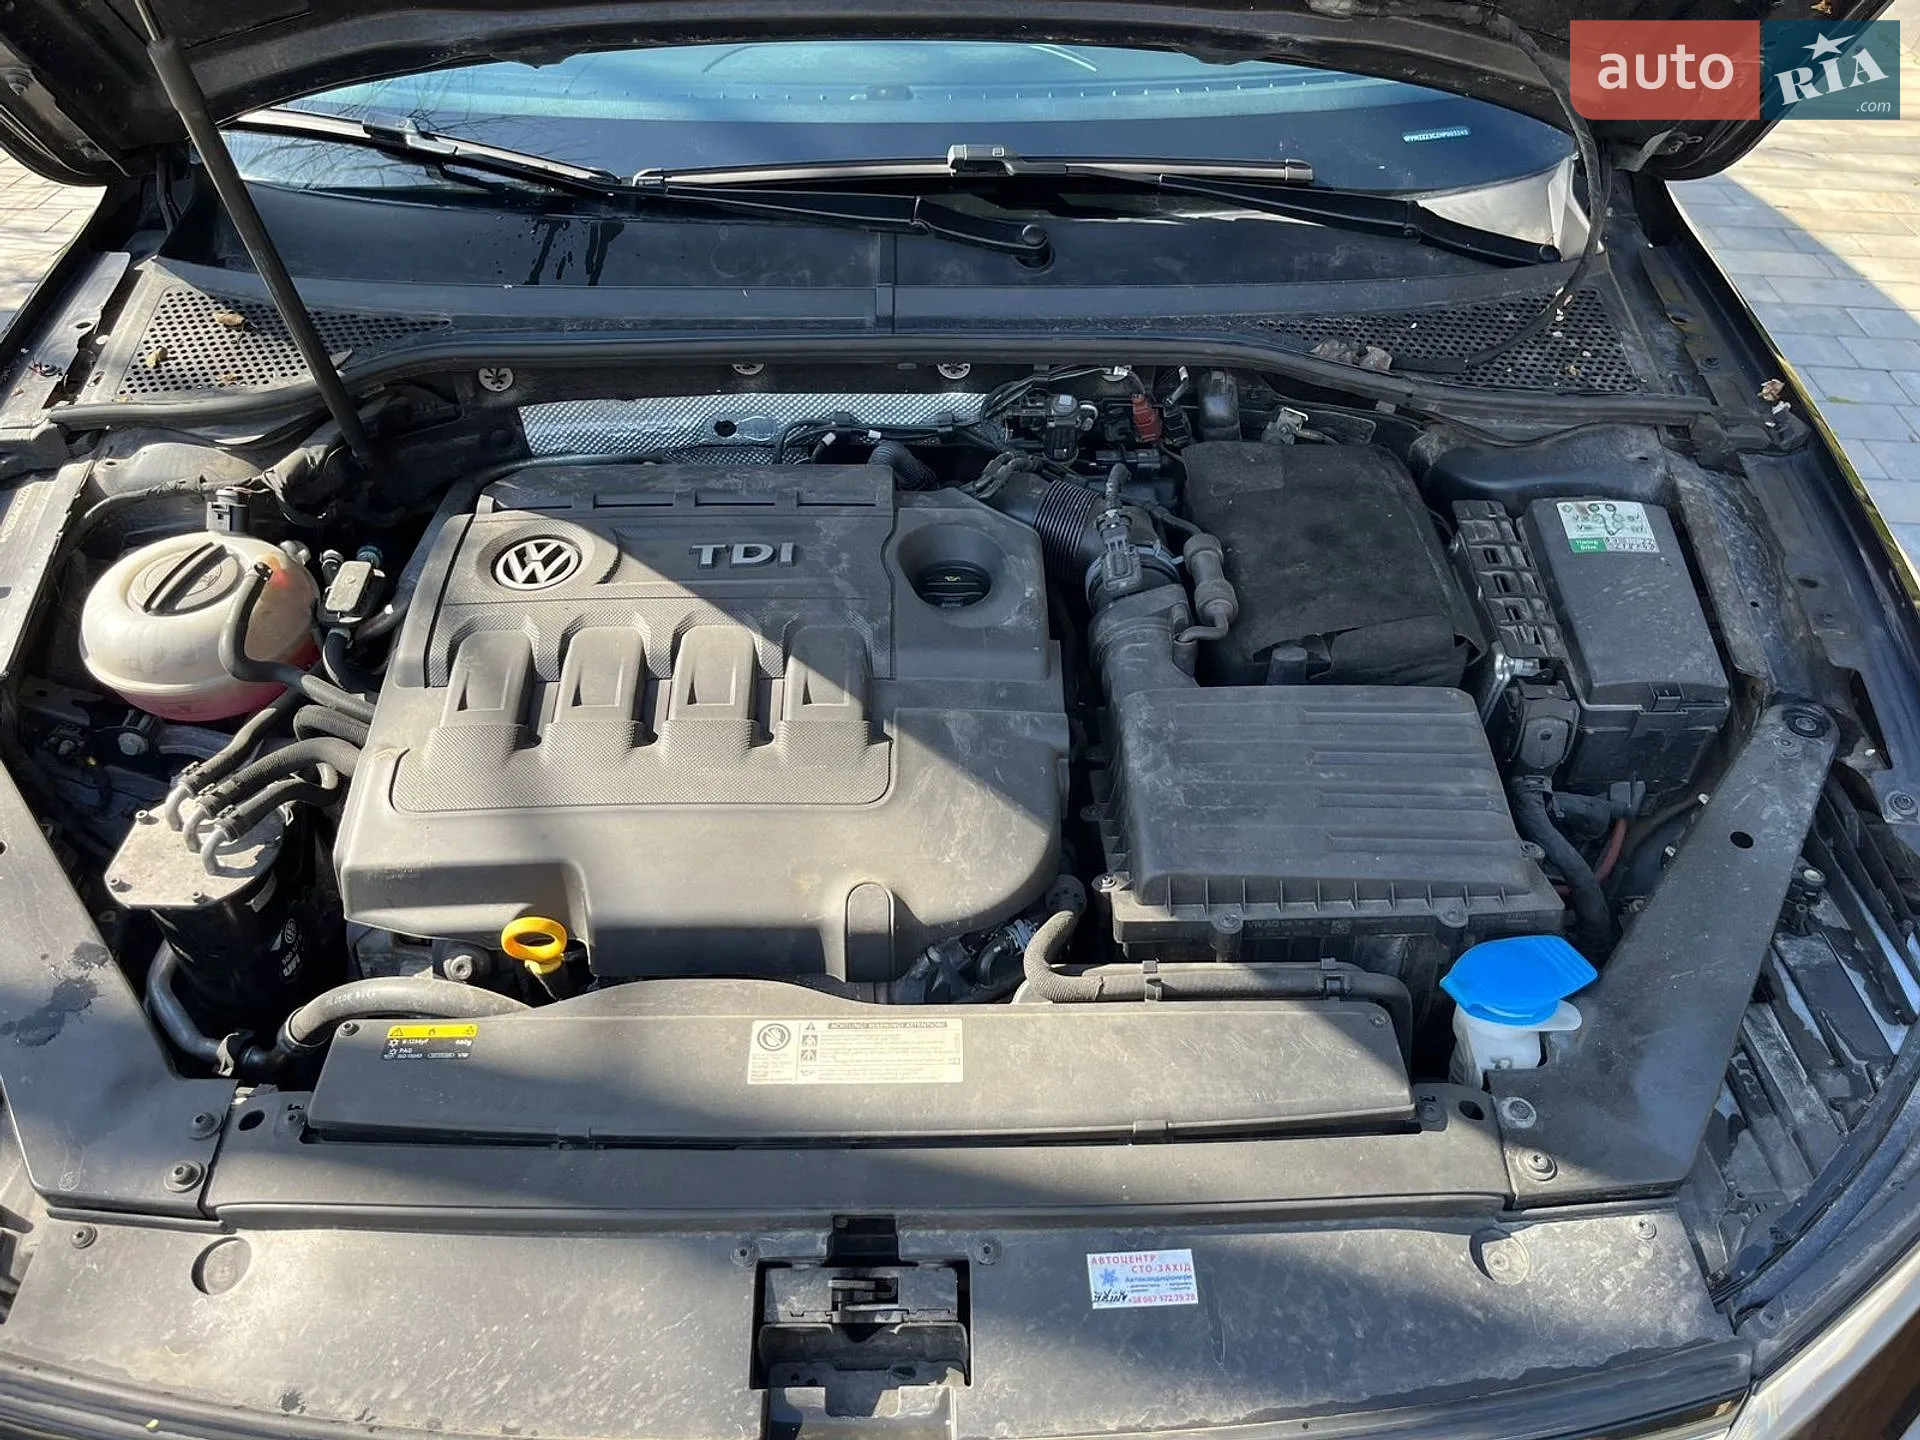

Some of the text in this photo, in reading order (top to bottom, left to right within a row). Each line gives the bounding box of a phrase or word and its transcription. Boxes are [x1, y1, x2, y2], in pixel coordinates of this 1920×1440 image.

[691, 542, 795, 567] TDI
[1091, 1254, 1157, 1265] АВТОЦЕНТР
[1131, 1263, 1192, 1274] СТО-ЗАХІД
